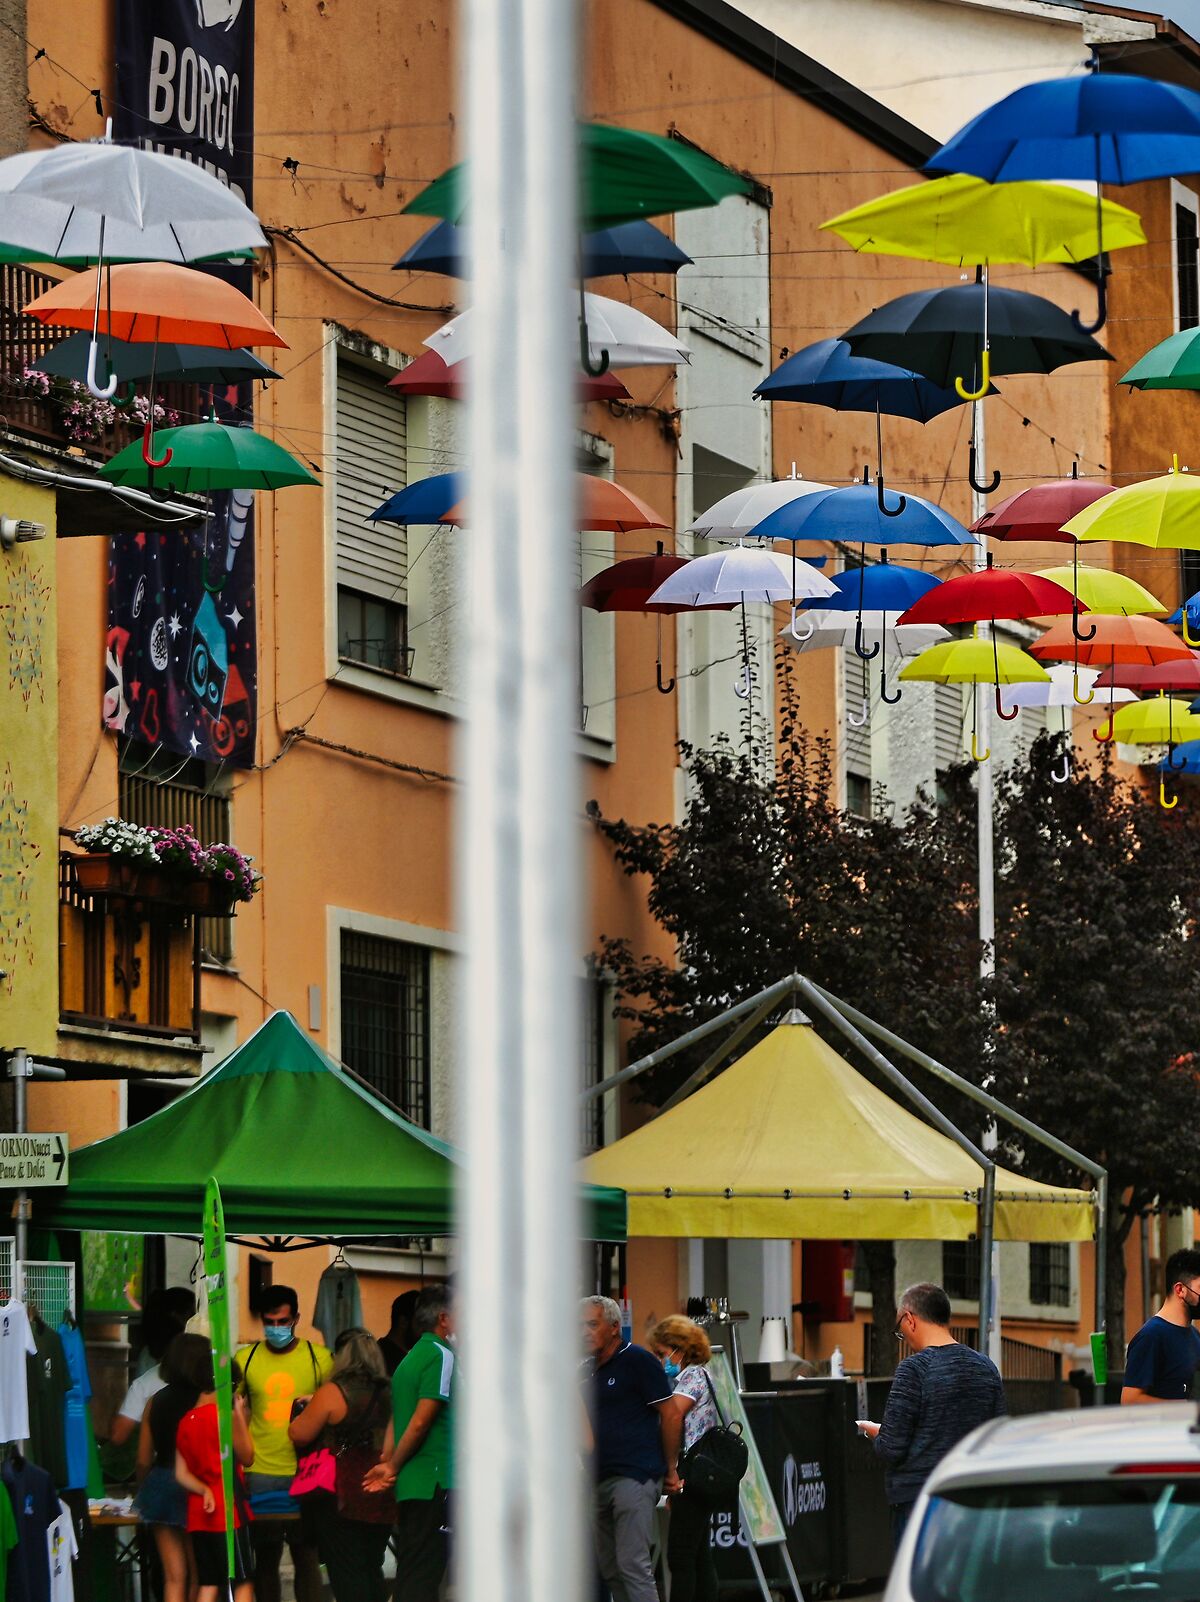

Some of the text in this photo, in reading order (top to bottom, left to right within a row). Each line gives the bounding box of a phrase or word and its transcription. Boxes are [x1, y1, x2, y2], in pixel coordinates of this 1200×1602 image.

[0, 1137, 30, 1157] ORNO
[18, 1161, 25, 1179] &
[27, 1158, 46, 1178] Dolci
[798, 1481, 826, 1513] BORGO
